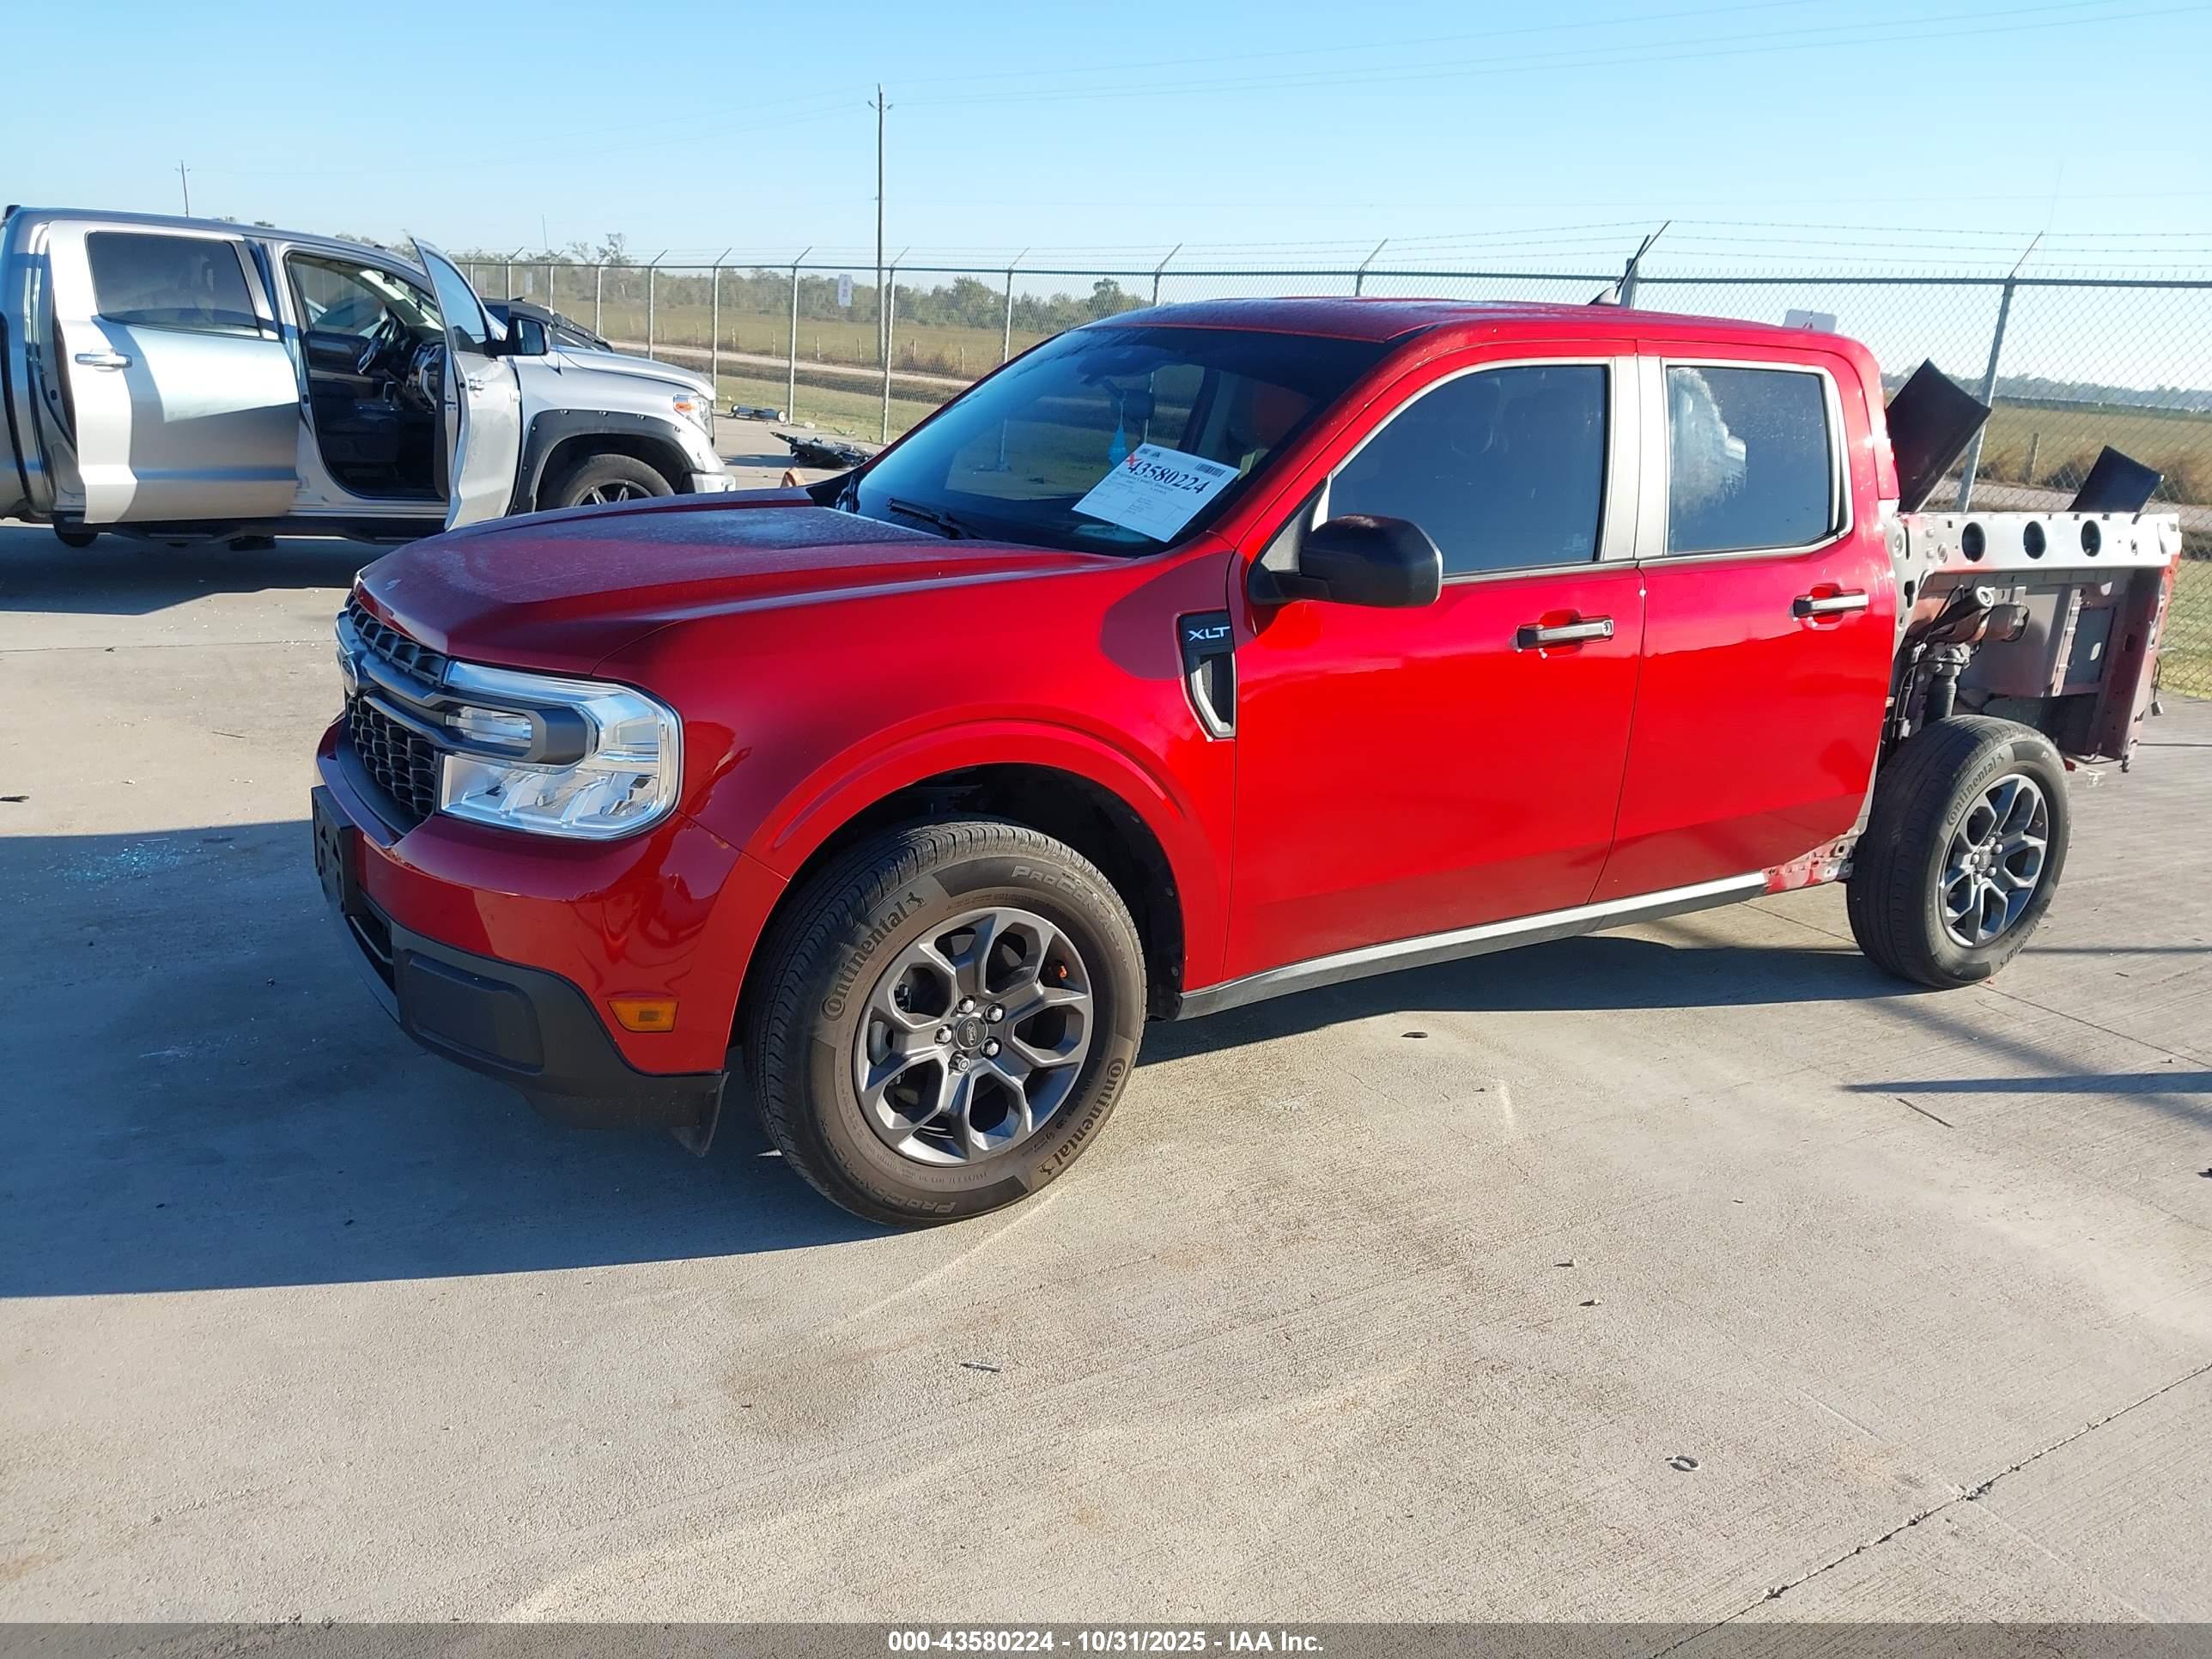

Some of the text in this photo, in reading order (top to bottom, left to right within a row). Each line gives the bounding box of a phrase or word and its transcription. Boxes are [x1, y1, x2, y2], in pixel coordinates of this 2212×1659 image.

[1127, 459, 1210, 494] 43580224
[1188, 626, 1231, 641] XLT
[1947, 757, 1997, 826] Continental
[819, 902, 909, 1021] Continental
[1052, 1057, 1127, 1166] Continental
